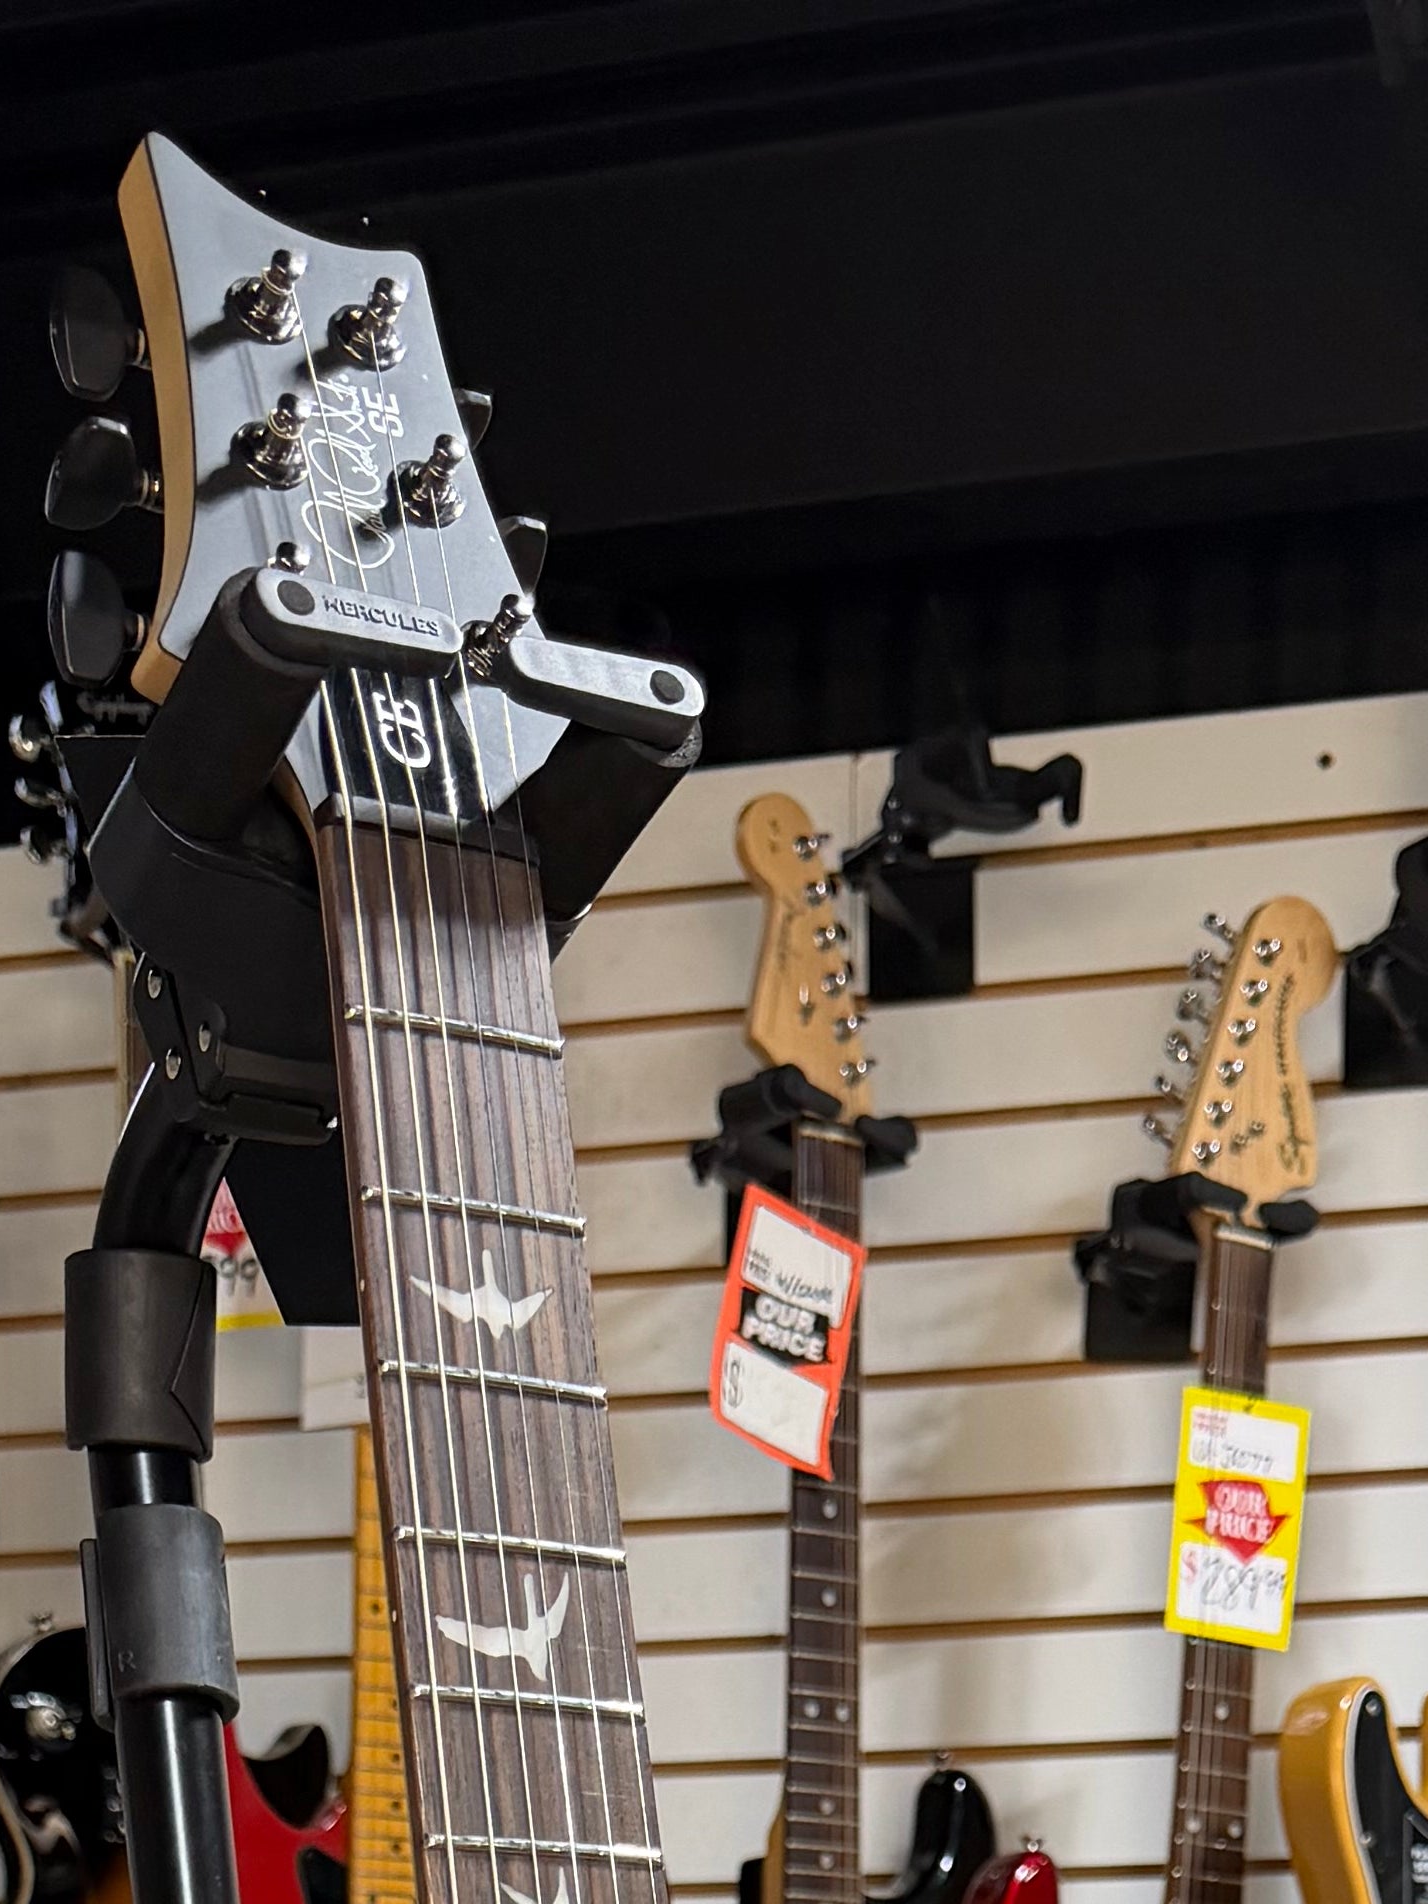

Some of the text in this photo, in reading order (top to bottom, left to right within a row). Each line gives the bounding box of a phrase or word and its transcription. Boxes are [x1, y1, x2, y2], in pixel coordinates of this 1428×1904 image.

[361, 386, 404, 438] SE
[321, 595, 440, 638] HERCULES
[372, 691, 432, 769] CE
[205, 1252, 260, 1298] 99
[753, 1293, 818, 1336] OUR
[739, 1312, 826, 1363] PRICE
[1213, 1483, 1266, 1518] OUR
[1204, 1509, 1274, 1545] PRICE
